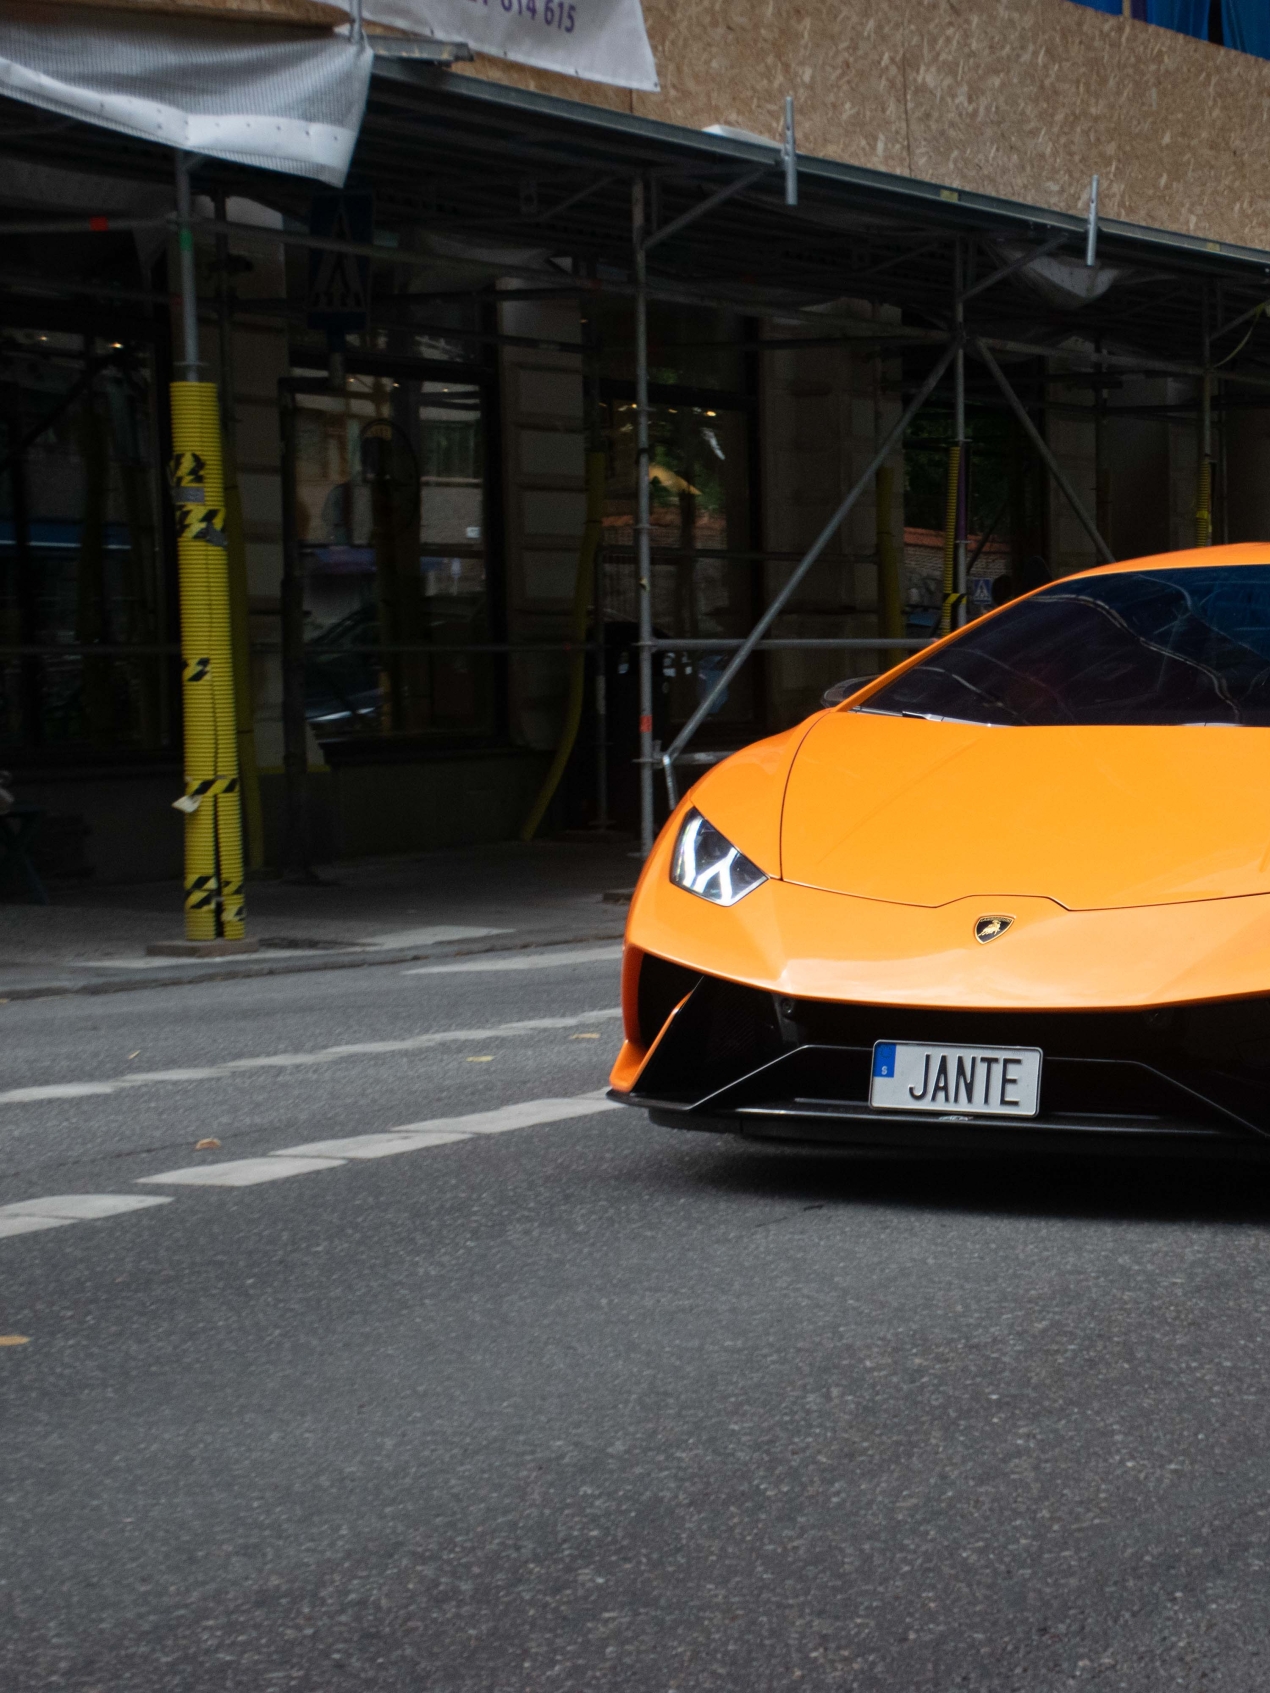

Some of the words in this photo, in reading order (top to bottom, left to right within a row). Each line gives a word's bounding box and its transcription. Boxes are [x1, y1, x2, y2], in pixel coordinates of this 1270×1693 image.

[544, 0, 576, 33] 615
[881, 1066, 888, 1075] S
[908, 1053, 1022, 1106] JANTE
